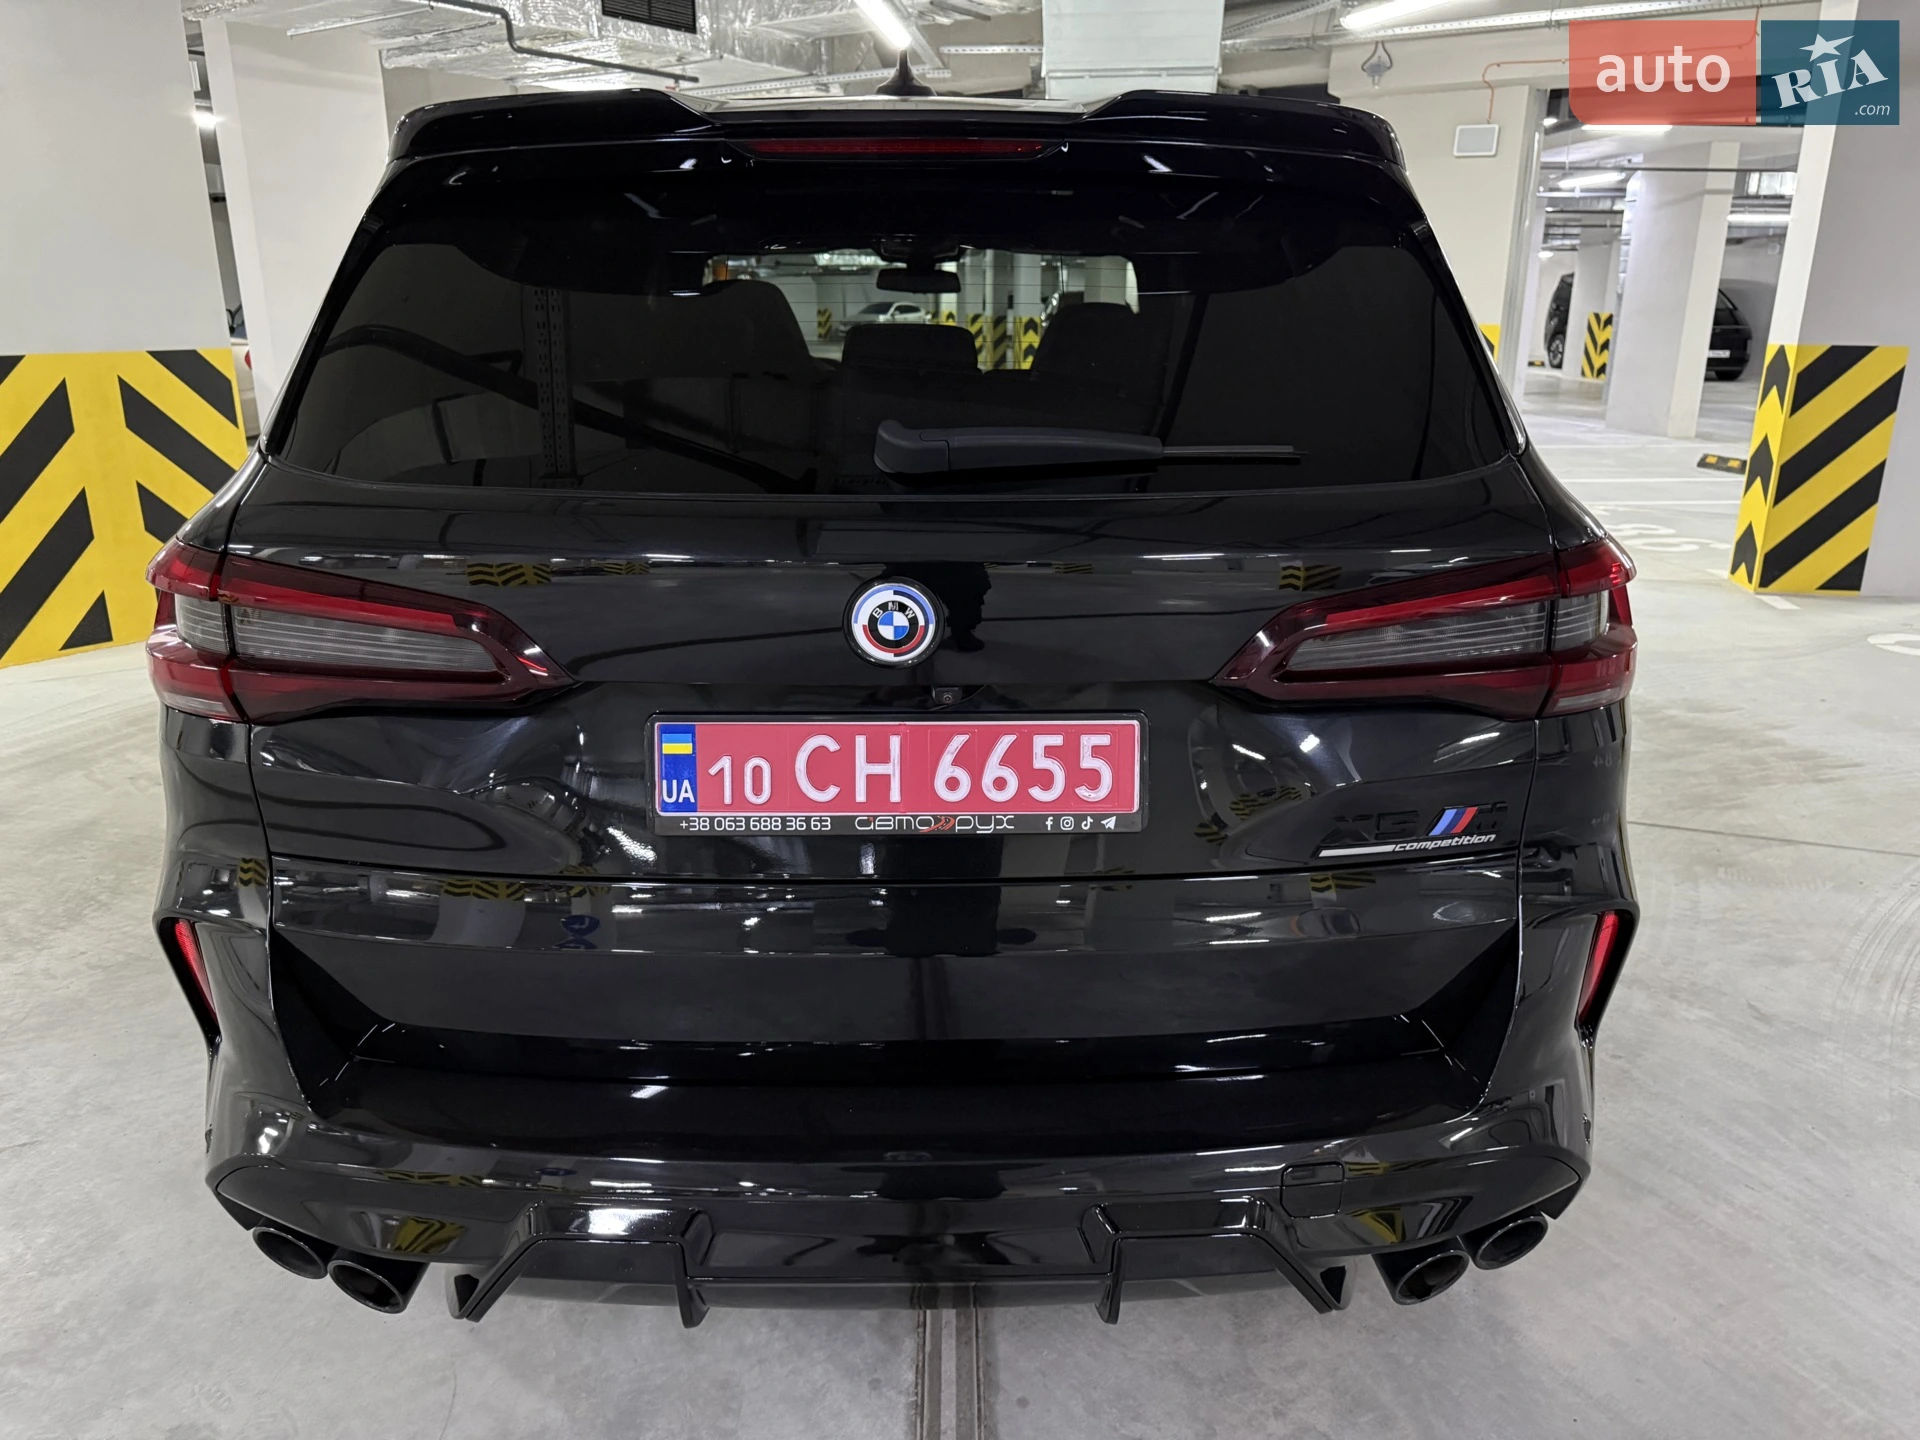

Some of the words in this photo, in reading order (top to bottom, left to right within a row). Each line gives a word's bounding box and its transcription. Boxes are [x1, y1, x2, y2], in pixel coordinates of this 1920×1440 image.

[872, 601, 915, 619] BMW
[662, 779, 695, 803] UA
[707, 755, 772, 805] 10
[794, 734, 901, 803] CH
[933, 734, 1113, 803] 6655
[679, 817, 710, 831] +38
[714, 817, 746, 831] 063
[750, 817, 781, 831] 688
[785, 817, 807, 831] 36
[810, 817, 832, 831] 63
[1393, 834, 1496, 852] competition
